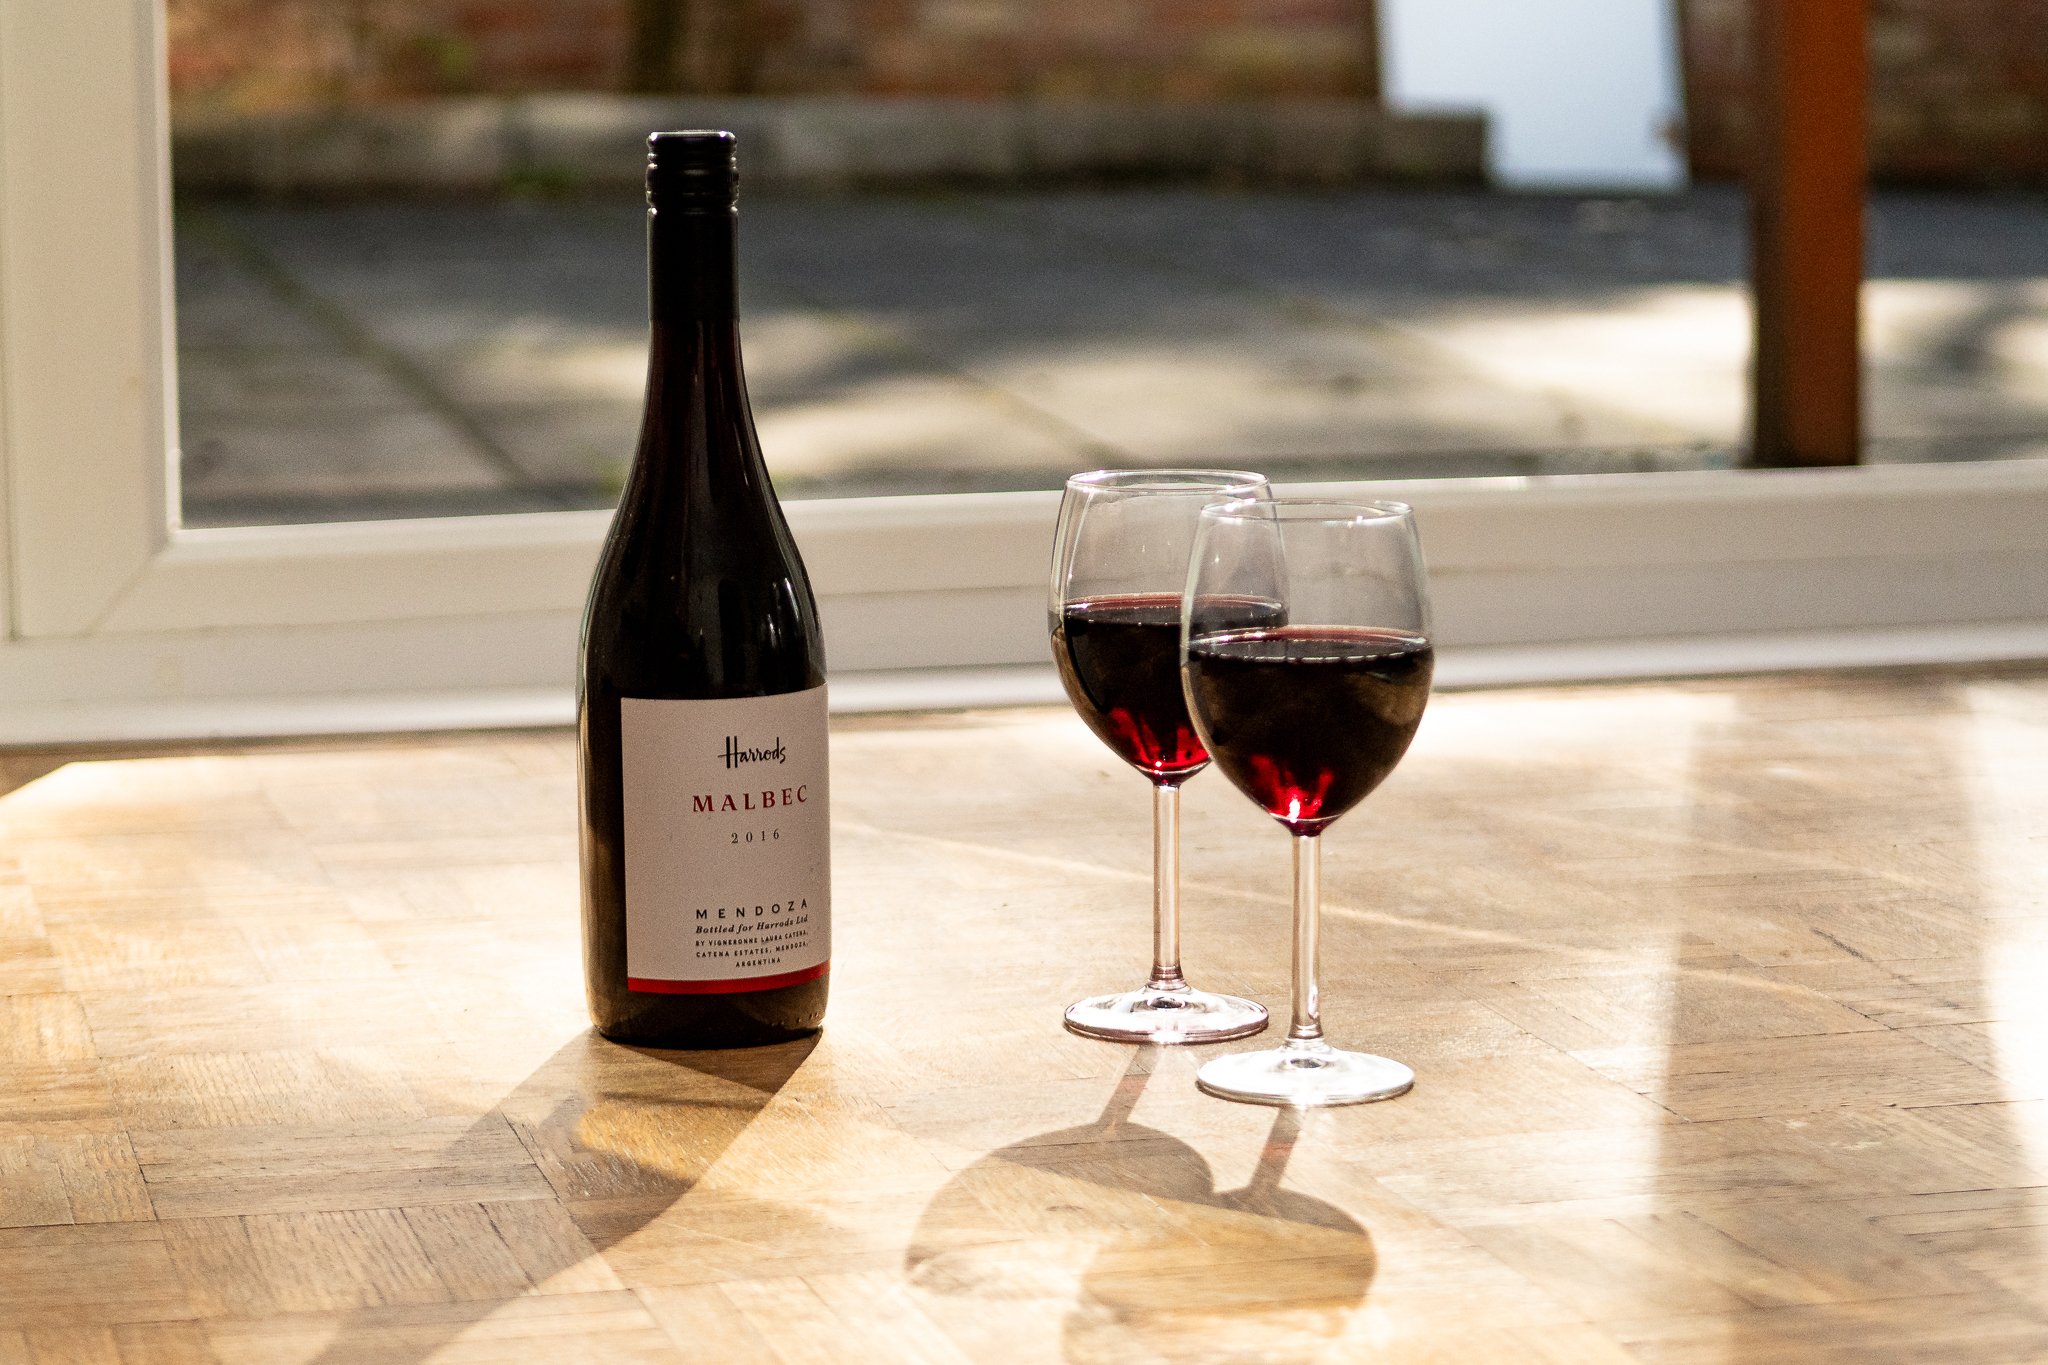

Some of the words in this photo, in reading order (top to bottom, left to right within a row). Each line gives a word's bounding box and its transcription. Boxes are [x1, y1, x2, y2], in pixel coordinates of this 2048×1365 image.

[717, 735, 786, 769] Harrods
[692, 784, 808, 813] MALBEC
[731, 828, 780, 844] 2016
[695, 898, 808, 920] MENDOZA
[695, 924, 735, 934] Bottled
[736, 923, 754, 934] for
[756, 917, 794, 931] Harrods
[795, 914, 809, 925] Ltd
[695, 950, 730, 958] CATENA
[735, 957, 781, 968] ARGENTINA
